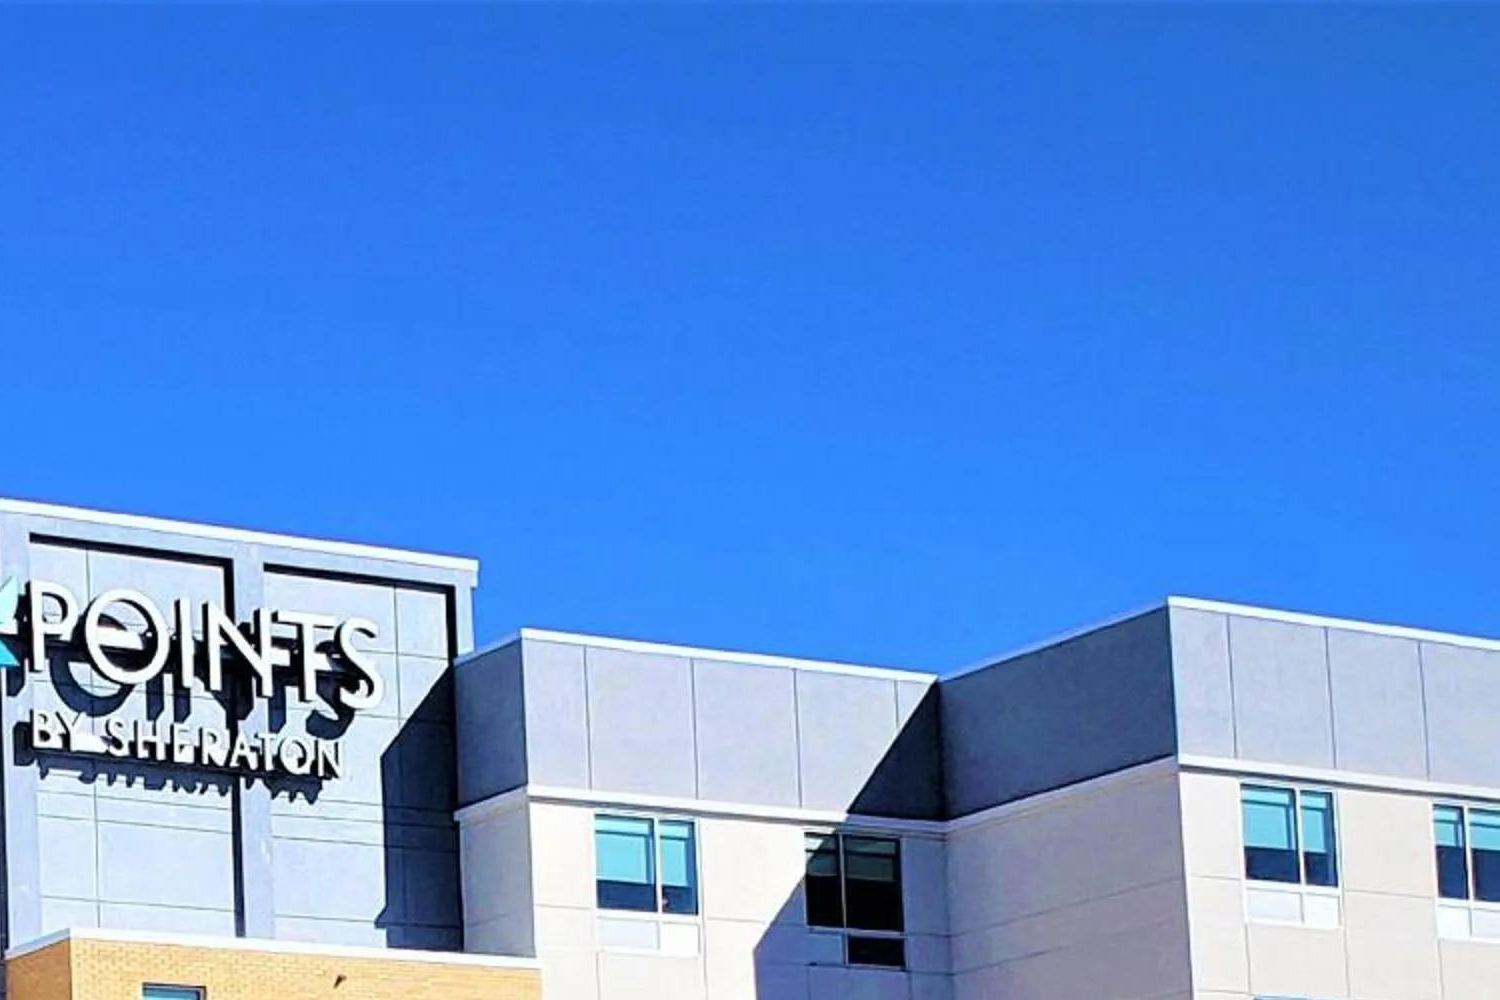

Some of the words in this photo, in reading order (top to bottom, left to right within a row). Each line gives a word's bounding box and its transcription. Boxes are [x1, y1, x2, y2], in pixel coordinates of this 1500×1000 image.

[28, 579, 384, 710] POINTS
[31, 708, 86, 752] BY
[105, 718, 343, 779] SHERATON
